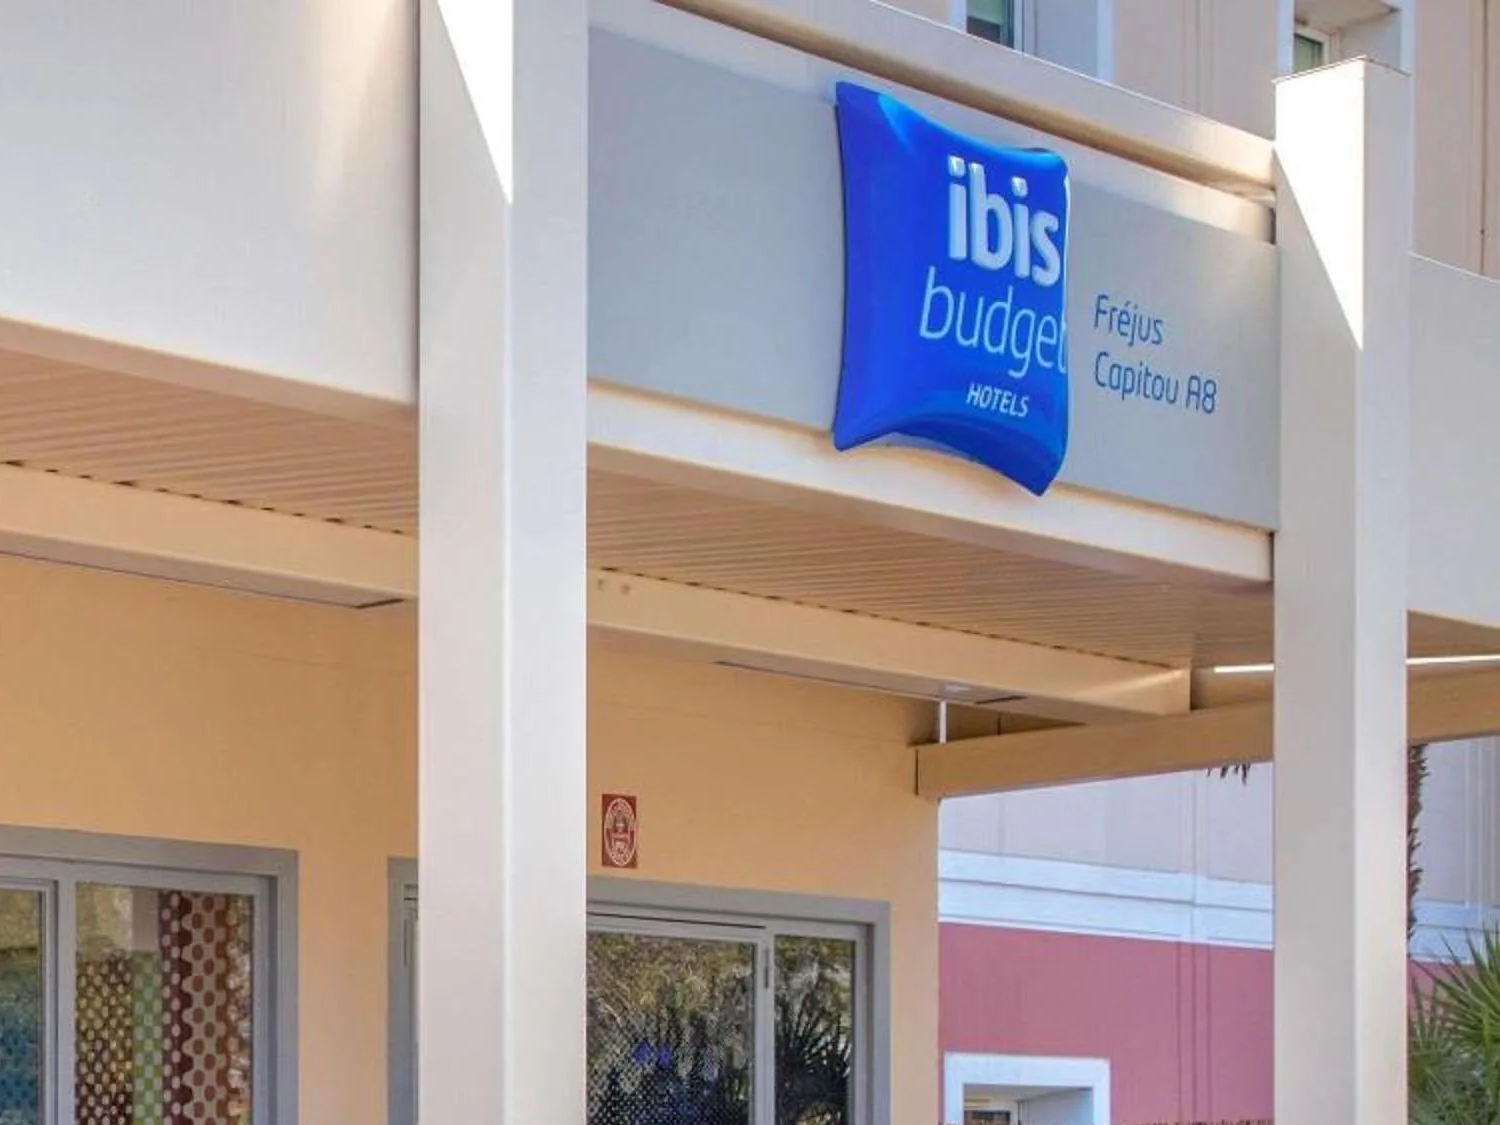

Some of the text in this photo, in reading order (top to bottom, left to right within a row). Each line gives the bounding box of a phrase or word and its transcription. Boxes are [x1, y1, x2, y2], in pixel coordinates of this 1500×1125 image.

[948, 155, 1061, 287] ibis
[1094, 295, 1164, 346] Fréjus
[966, 383, 1029, 417] HOTELS
[1094, 351, 1217, 414] Capitou A8
